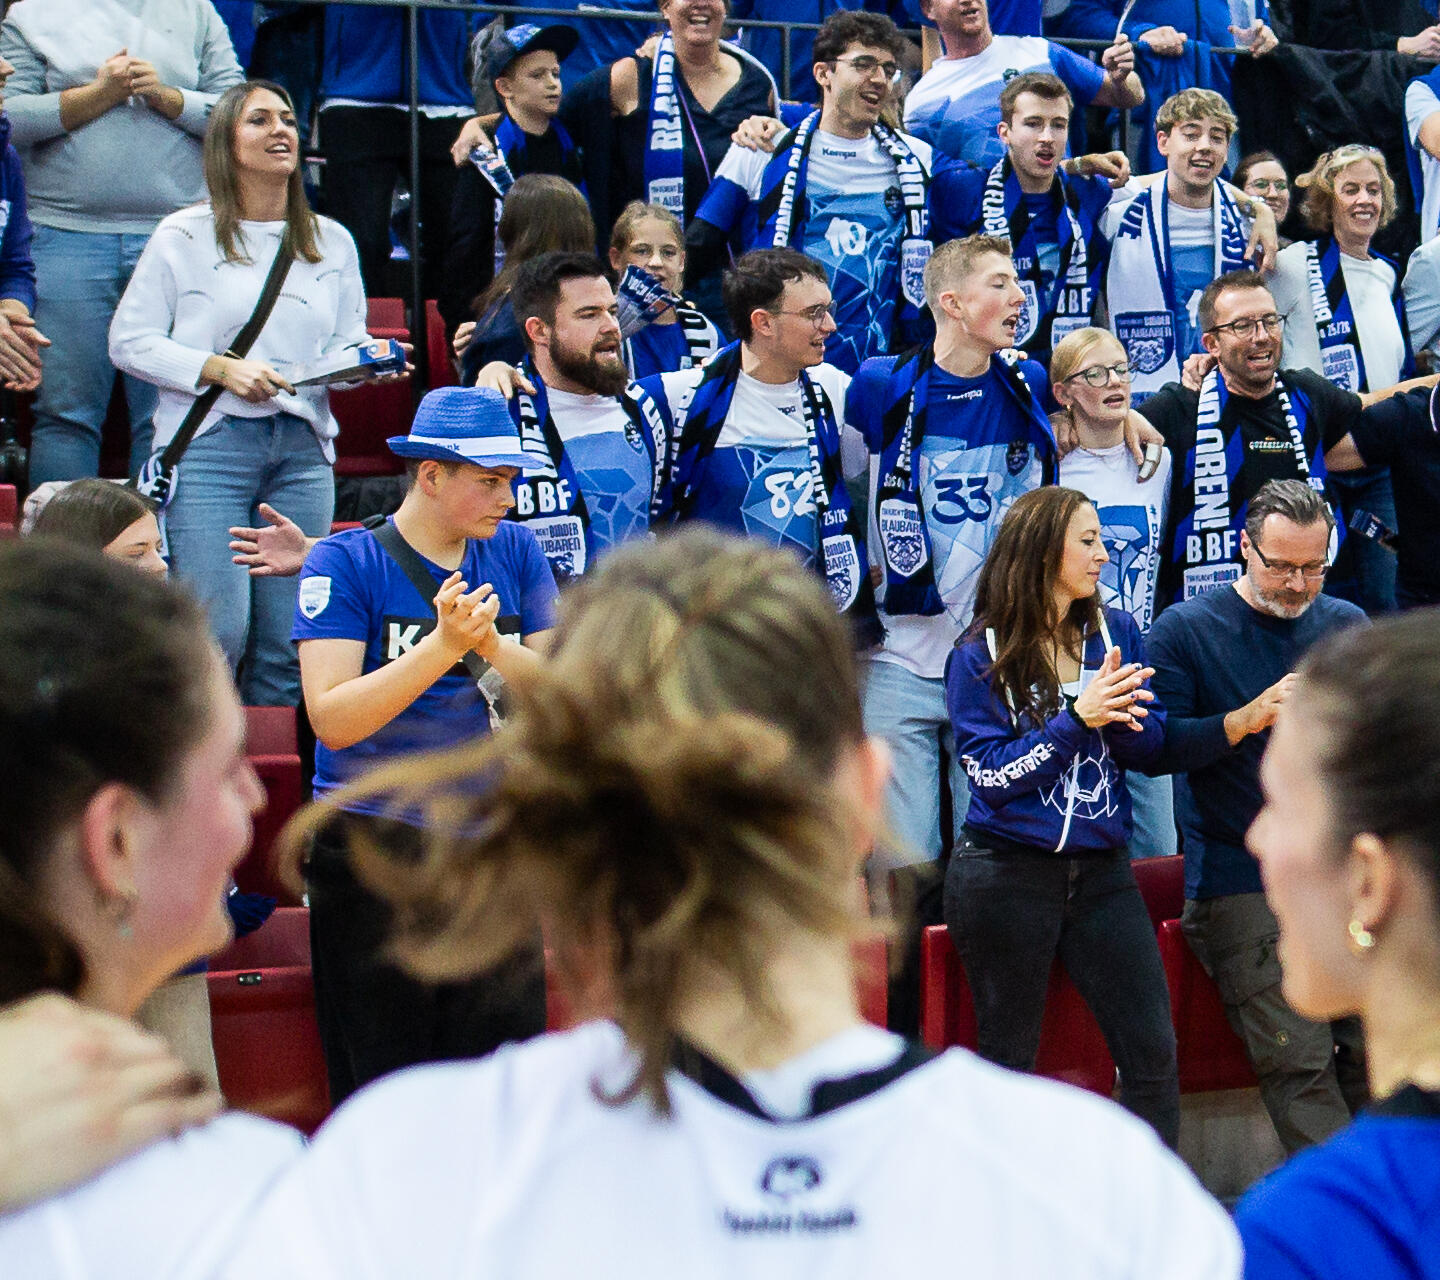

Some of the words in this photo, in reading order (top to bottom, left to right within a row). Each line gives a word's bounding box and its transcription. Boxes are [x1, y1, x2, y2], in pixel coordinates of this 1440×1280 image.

[822, 147, 857, 161] Kempa
[517, 478, 573, 516] BBF
[769, 471, 816, 520] 82
[1193, 428, 1231, 530] OBEN!
[822, 508, 848, 527] 25/26
[931, 476, 992, 525] 33
[548, 521, 579, 538] BINDER
[1186, 528, 1237, 564] BBF
[824, 539, 852, 558] BINDER
